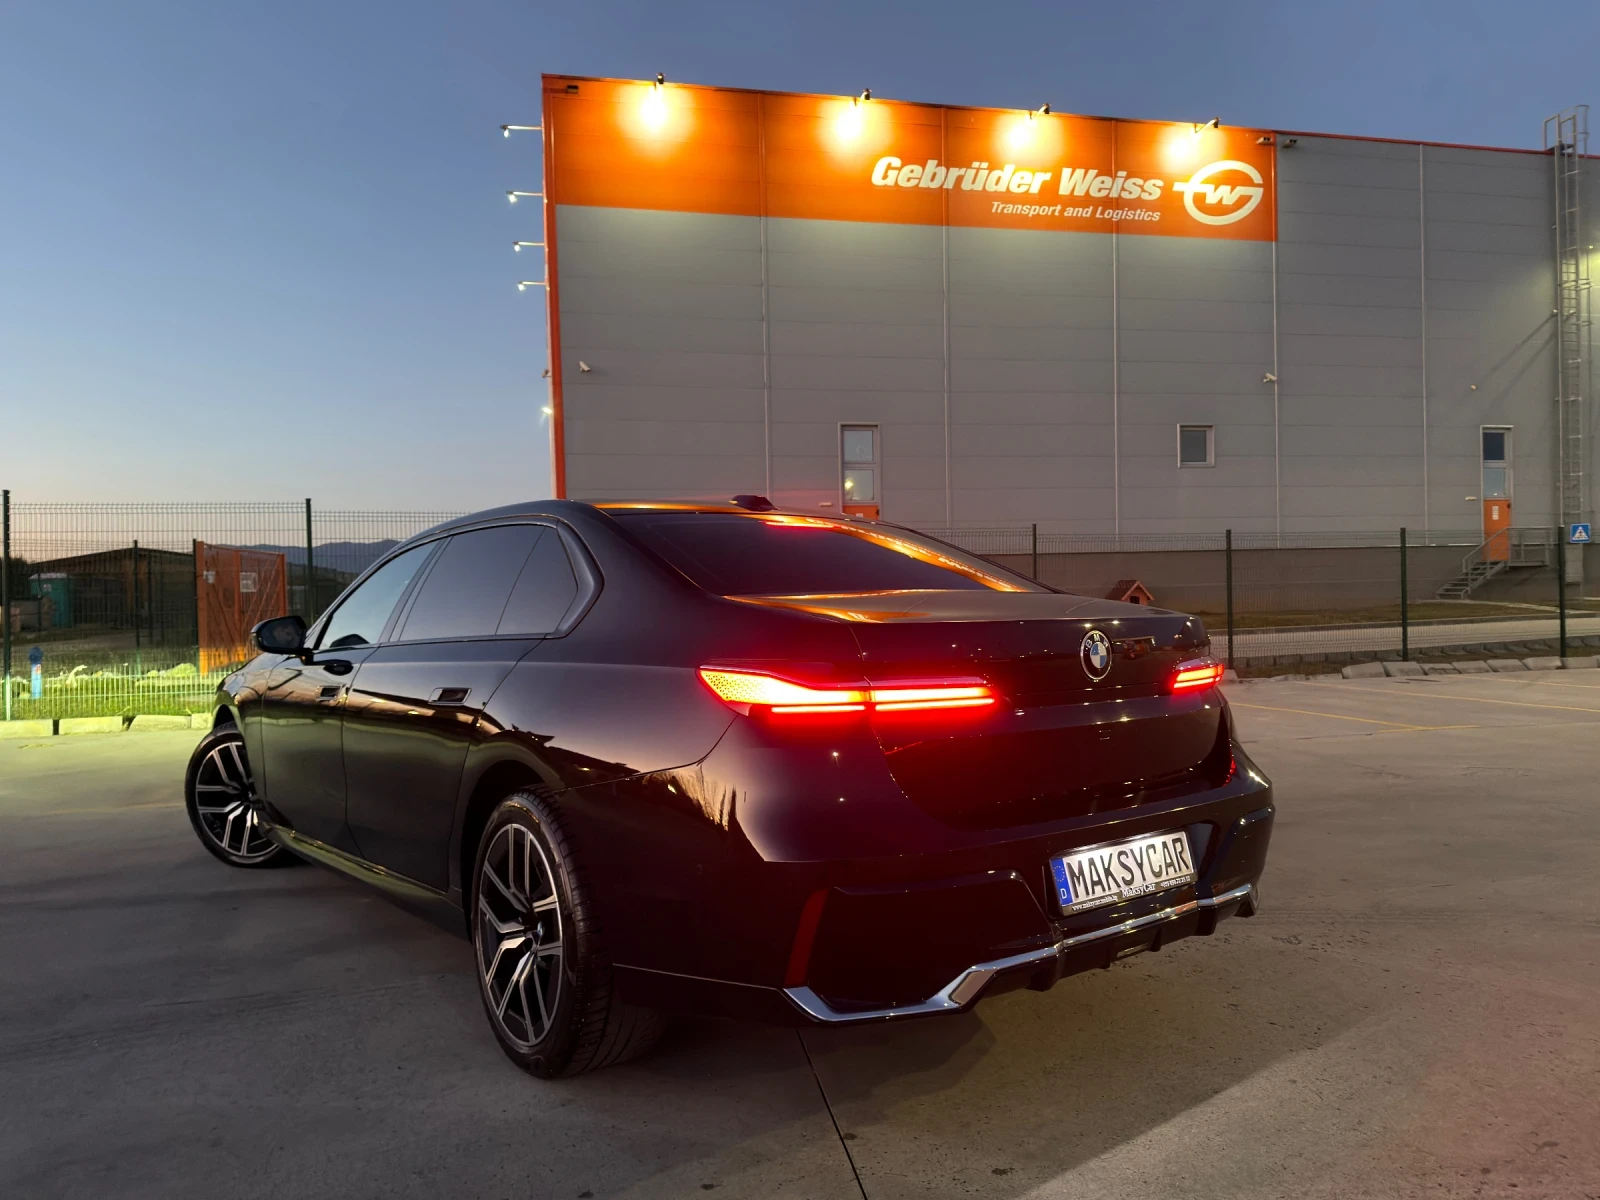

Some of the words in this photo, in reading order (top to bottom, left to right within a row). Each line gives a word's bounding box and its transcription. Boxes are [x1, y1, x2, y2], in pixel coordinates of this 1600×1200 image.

[871, 156, 1051, 194] Gebrüder
[1057, 167, 1164, 200] Weiss
[991, 201, 1061, 217] Transport
[1064, 206, 1092, 218] and
[1095, 206, 1161, 222] Logistics
[1066, 837, 1190, 899] MAKSYCAR
[1060, 888, 1068, 900] D
[1121, 882, 1157, 899] MaksyCar
